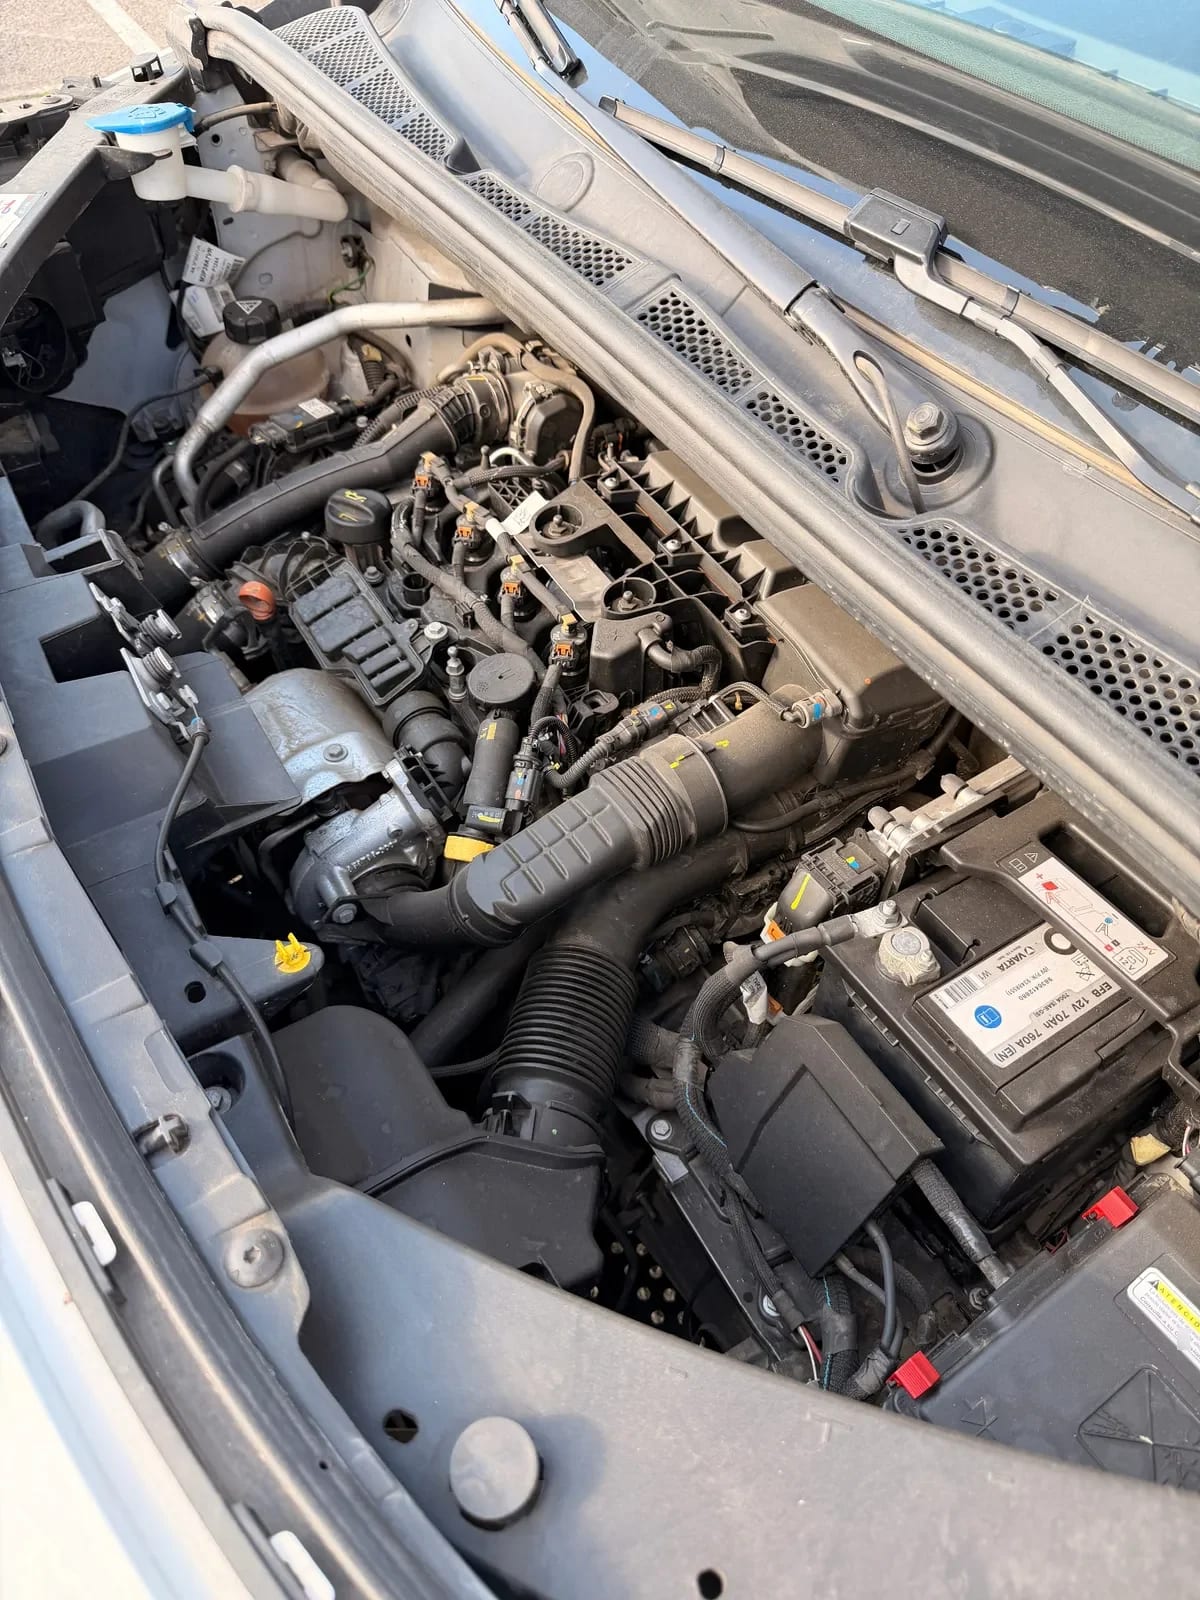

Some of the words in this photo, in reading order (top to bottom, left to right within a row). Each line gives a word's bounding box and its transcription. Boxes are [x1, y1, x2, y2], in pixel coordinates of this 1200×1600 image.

[996, 951, 1027, 972] VARTA
[978, 969, 992, 981] W1
[1091, 981, 1113, 998] EFB
[1071, 996, 1090, 1013] 12V
[1043, 1010, 1070, 1031] 70Ah
[1015, 1028, 1043, 1049] 760A
[993, 1044, 1017, 1063] (EN)
